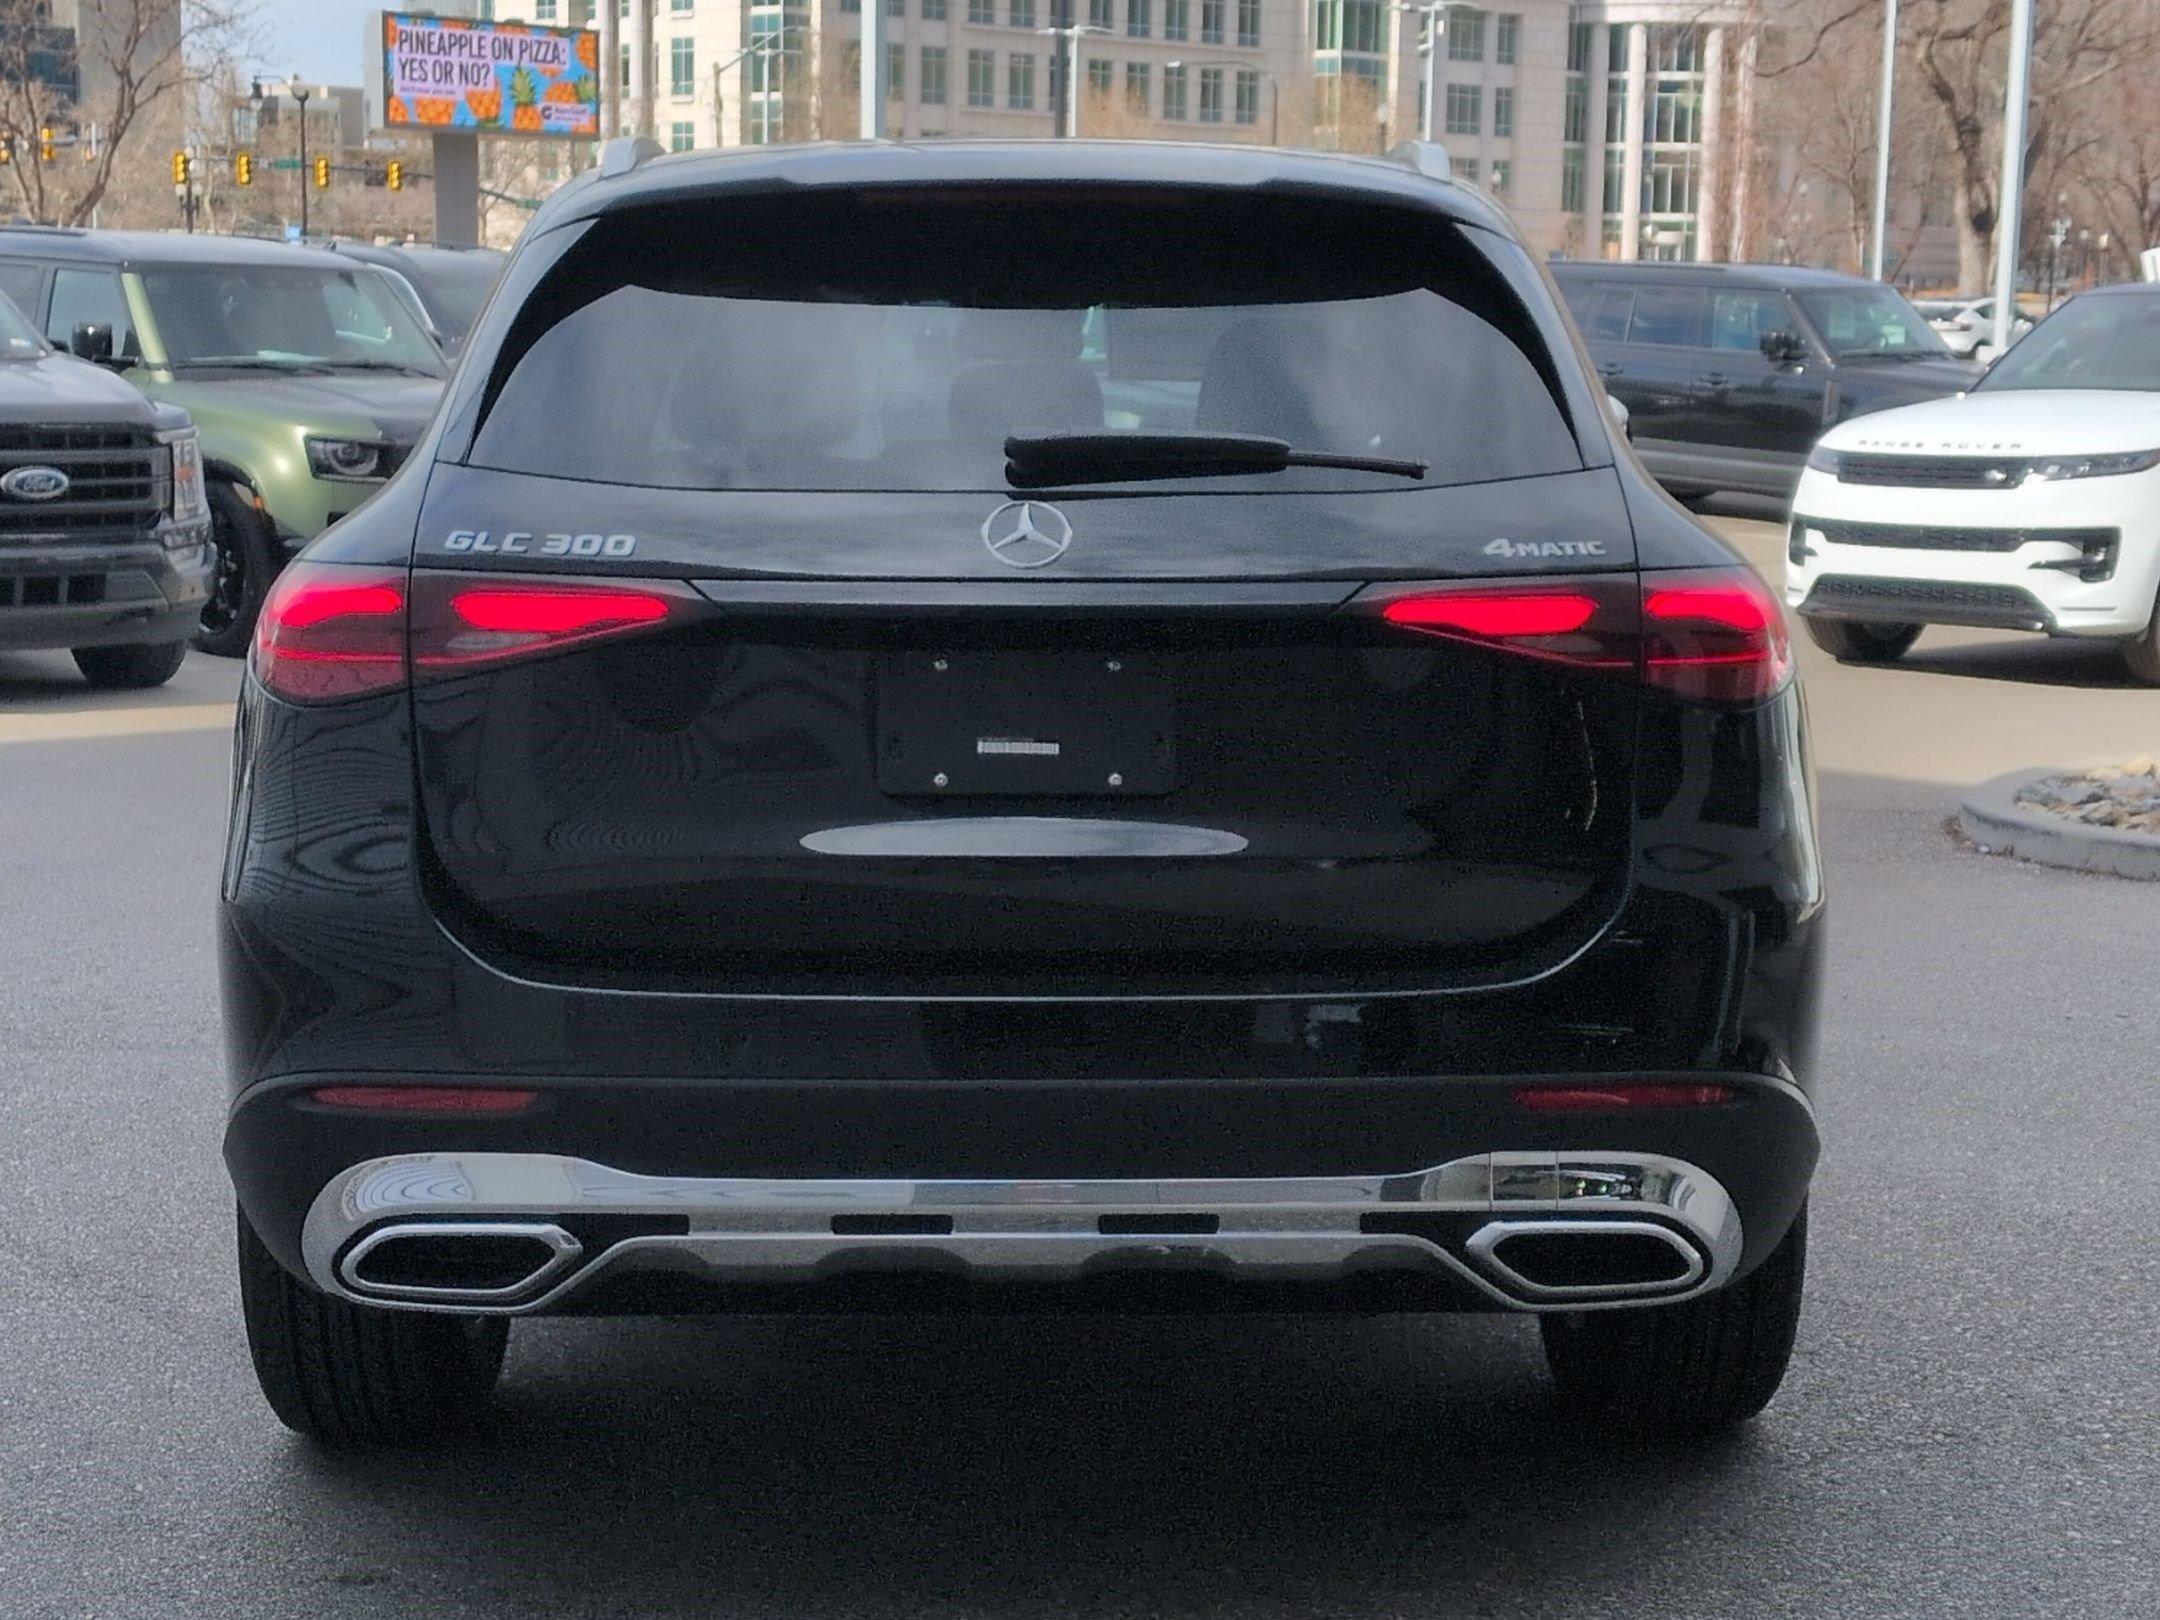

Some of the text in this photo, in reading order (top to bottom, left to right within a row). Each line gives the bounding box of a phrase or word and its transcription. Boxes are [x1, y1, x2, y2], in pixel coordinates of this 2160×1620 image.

[398, 28, 567, 65] PINEAPPLE ON PIZZA:
[398, 57, 491, 87] YES OR NO?
[1857, 439, 2023, 451] RANGE ROVER
[444, 530, 637, 557] GLC 300
[1483, 537, 1608, 559] 4MATIC
